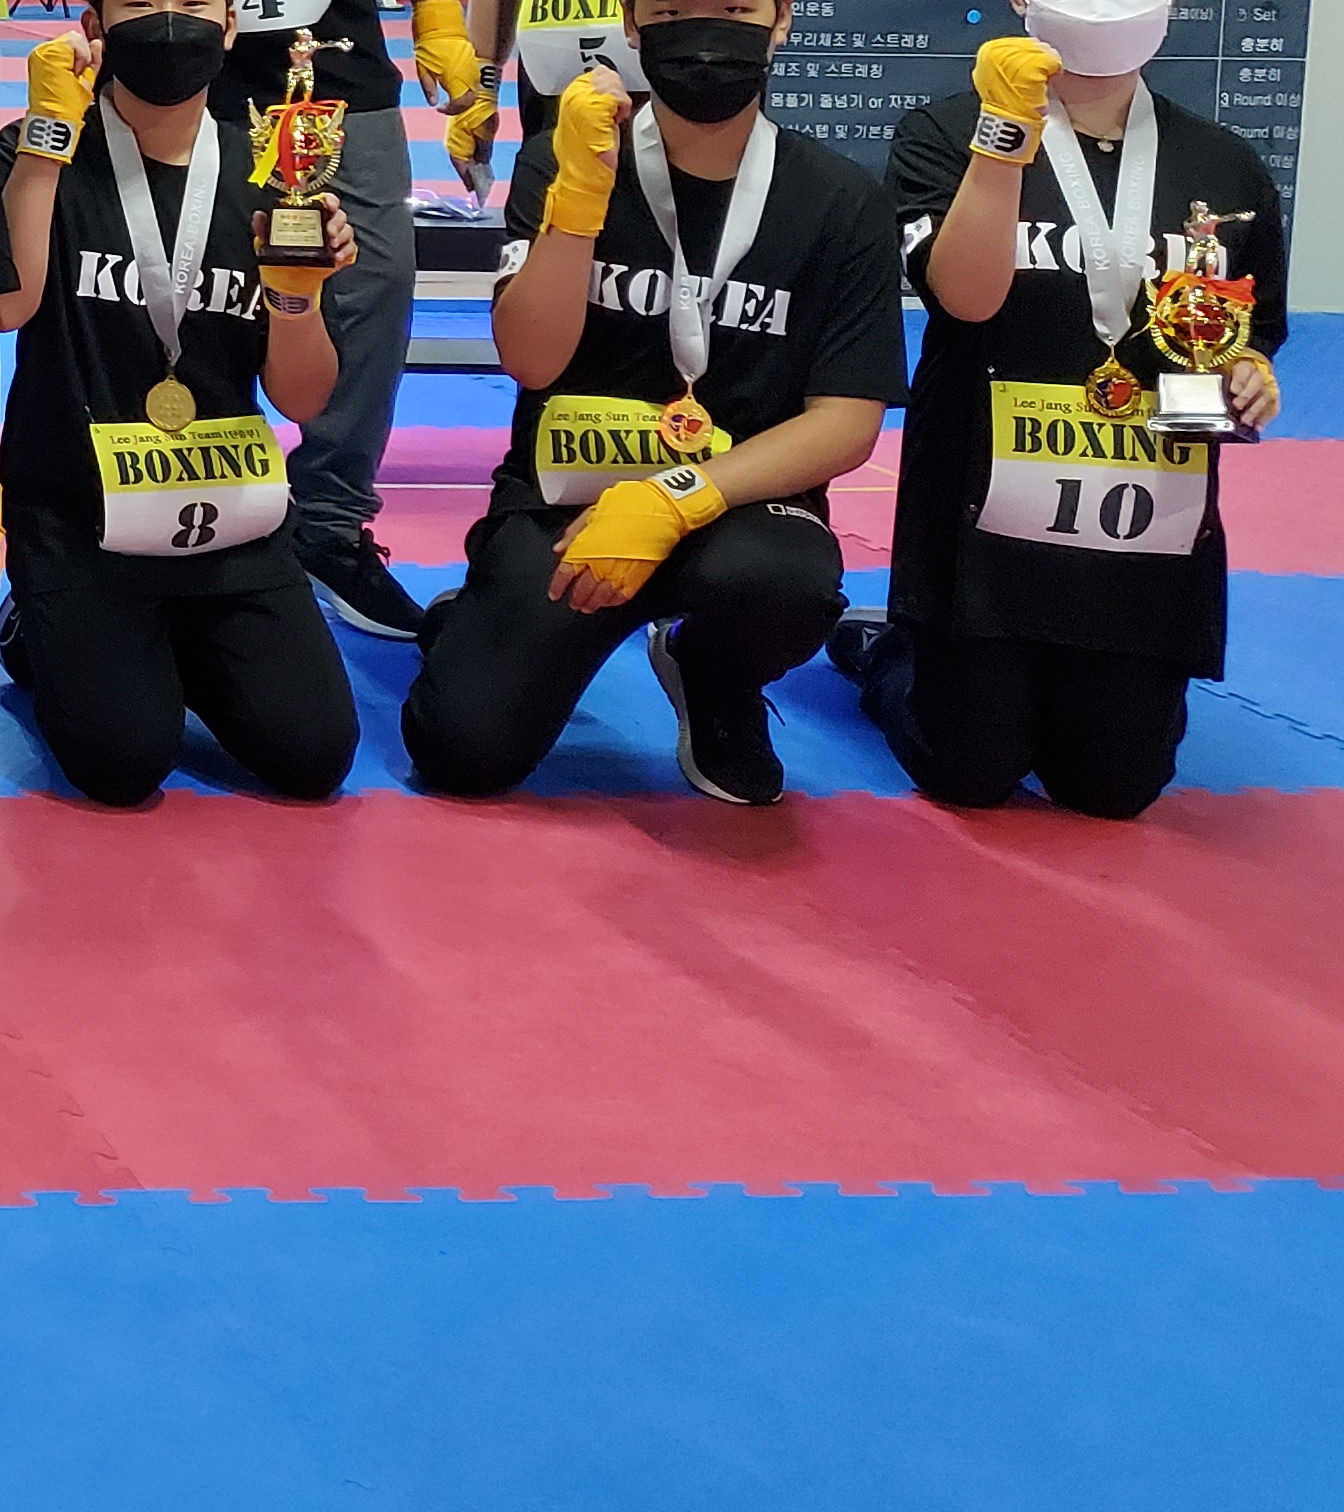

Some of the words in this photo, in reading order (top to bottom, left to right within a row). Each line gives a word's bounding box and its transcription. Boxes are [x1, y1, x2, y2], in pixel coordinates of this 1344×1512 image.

[112, 443, 271, 487] BOXING
[171, 502, 219, 549] 8
[1045, 478, 1154, 541] 10
